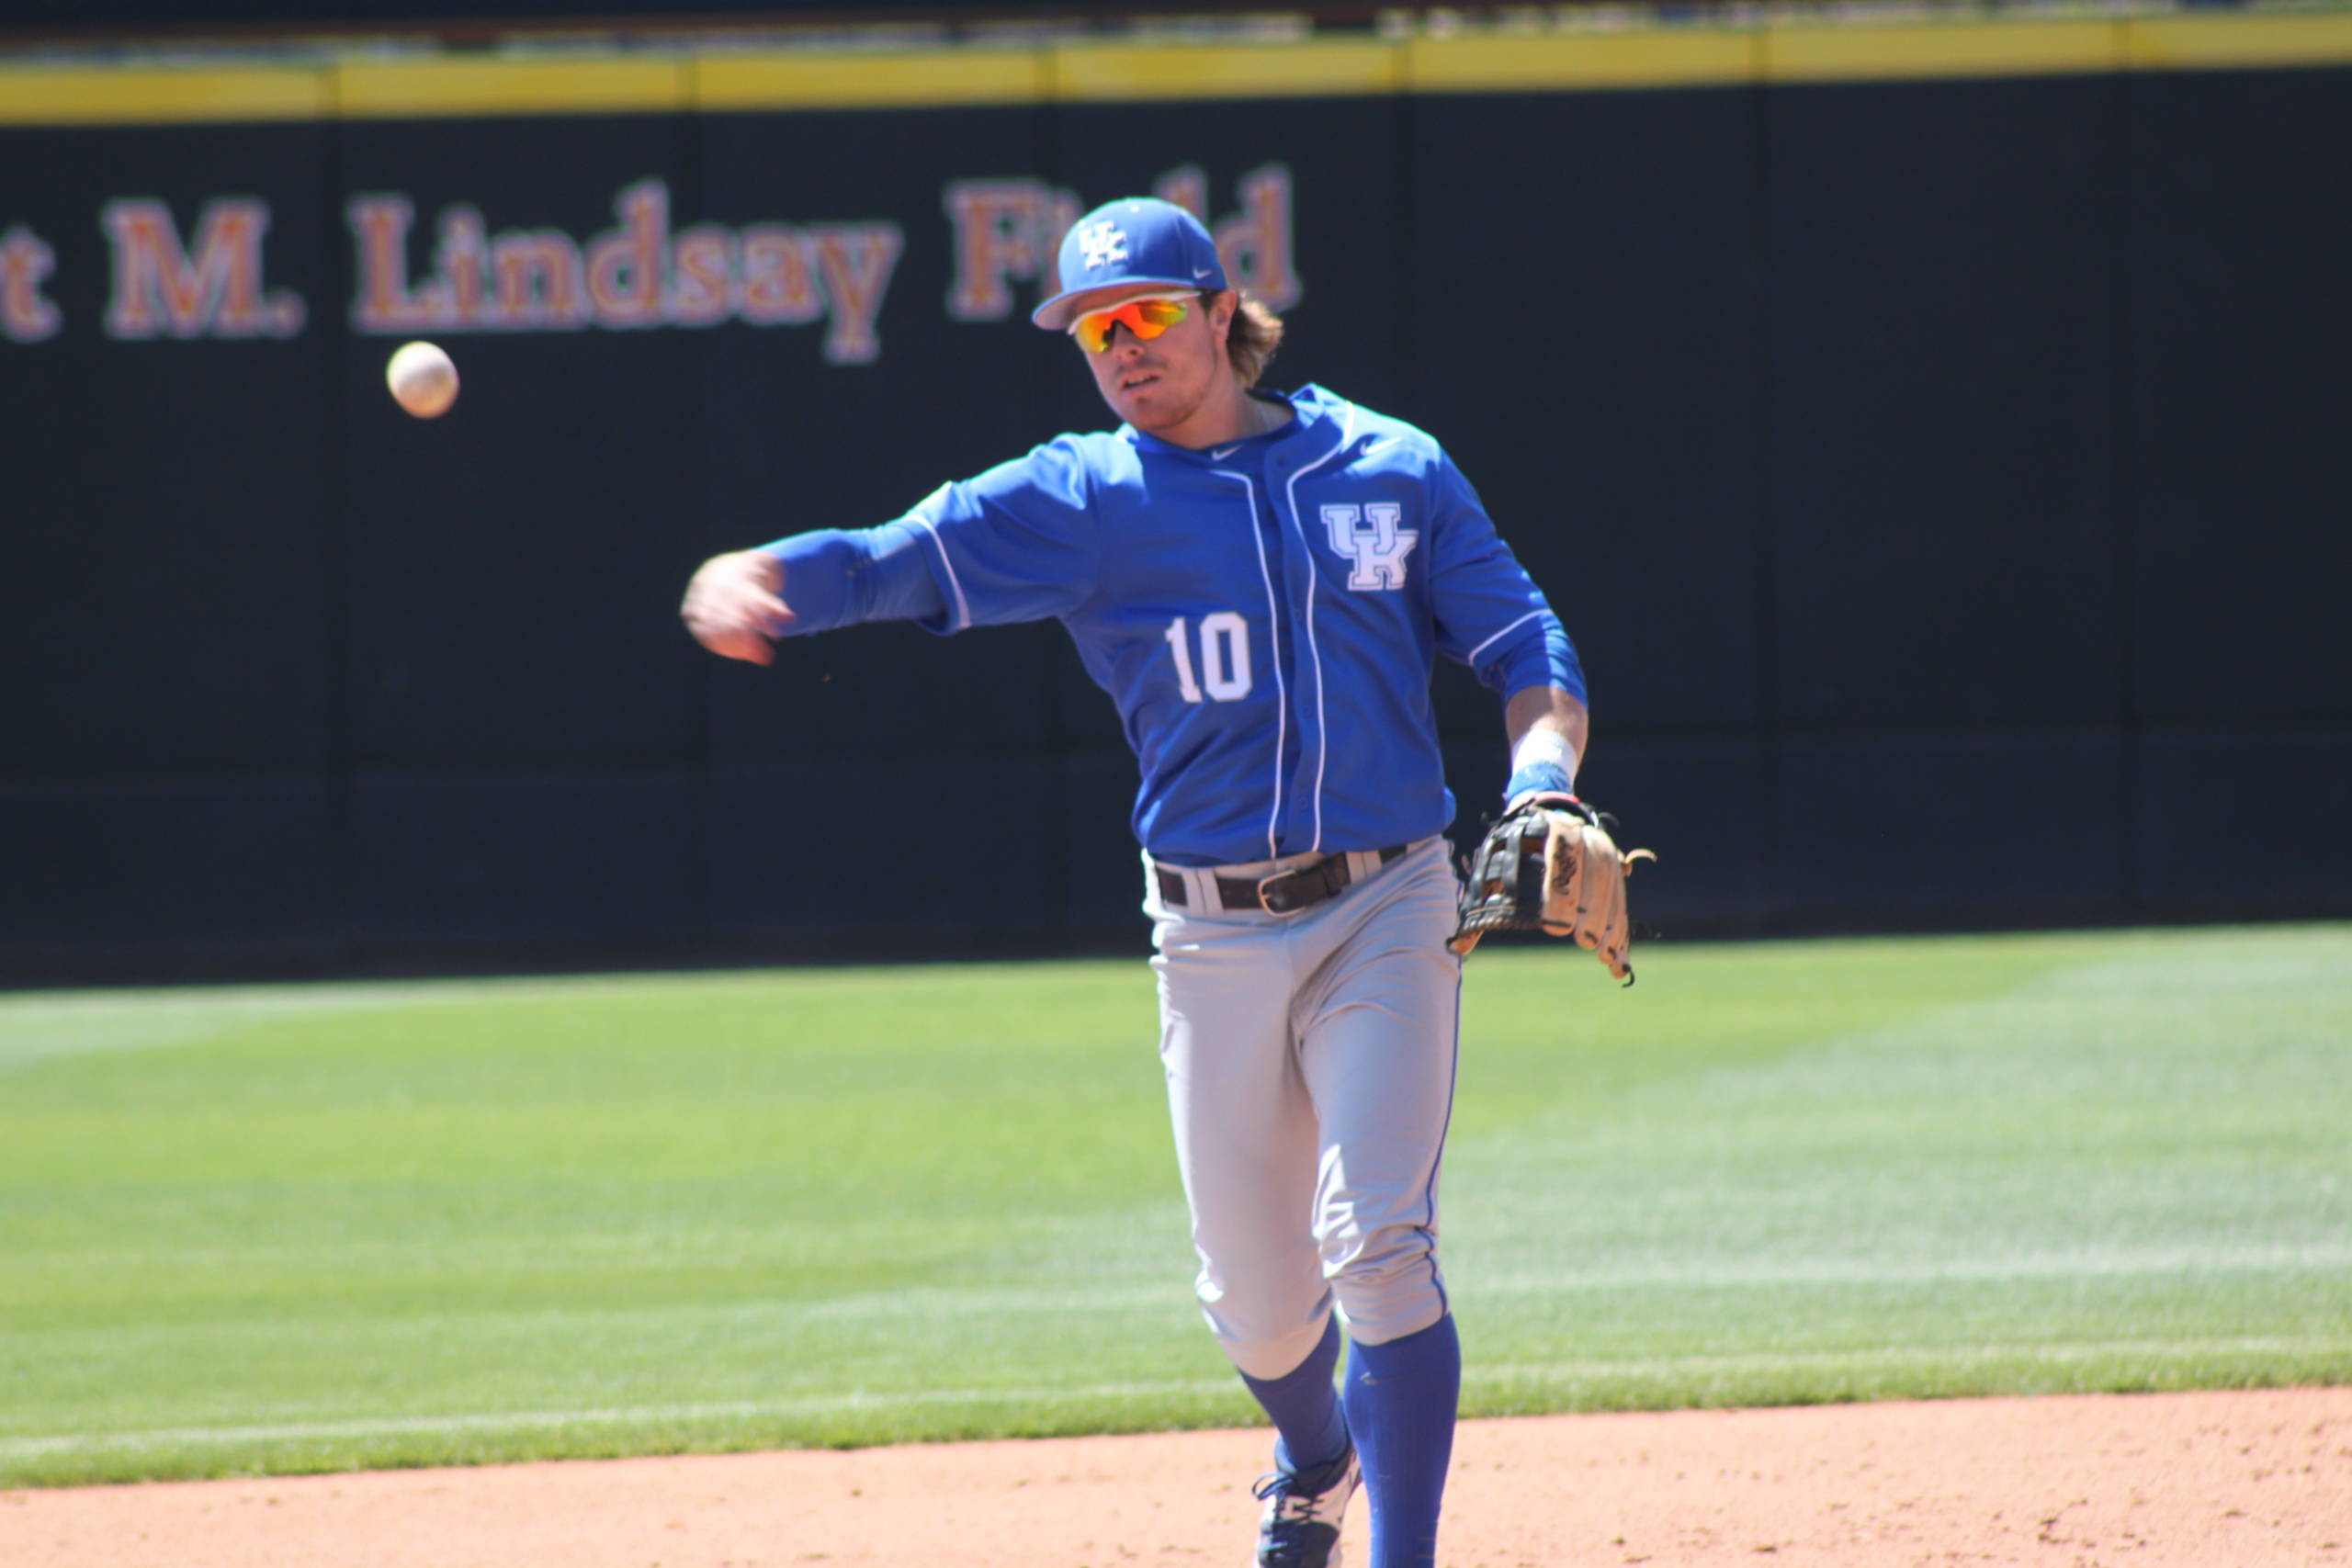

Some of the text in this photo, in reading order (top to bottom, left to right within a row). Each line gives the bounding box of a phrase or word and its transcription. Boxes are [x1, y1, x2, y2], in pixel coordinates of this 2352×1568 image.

[103, 197, 306, 340] M.
[347, 178, 904, 366] Lindsay
[944, 164, 1303, 321] Fid
[1077, 220, 1129, 271] UK
[1319, 502, 1419, 592] UK
[1164, 612, 1252, 704] 10
